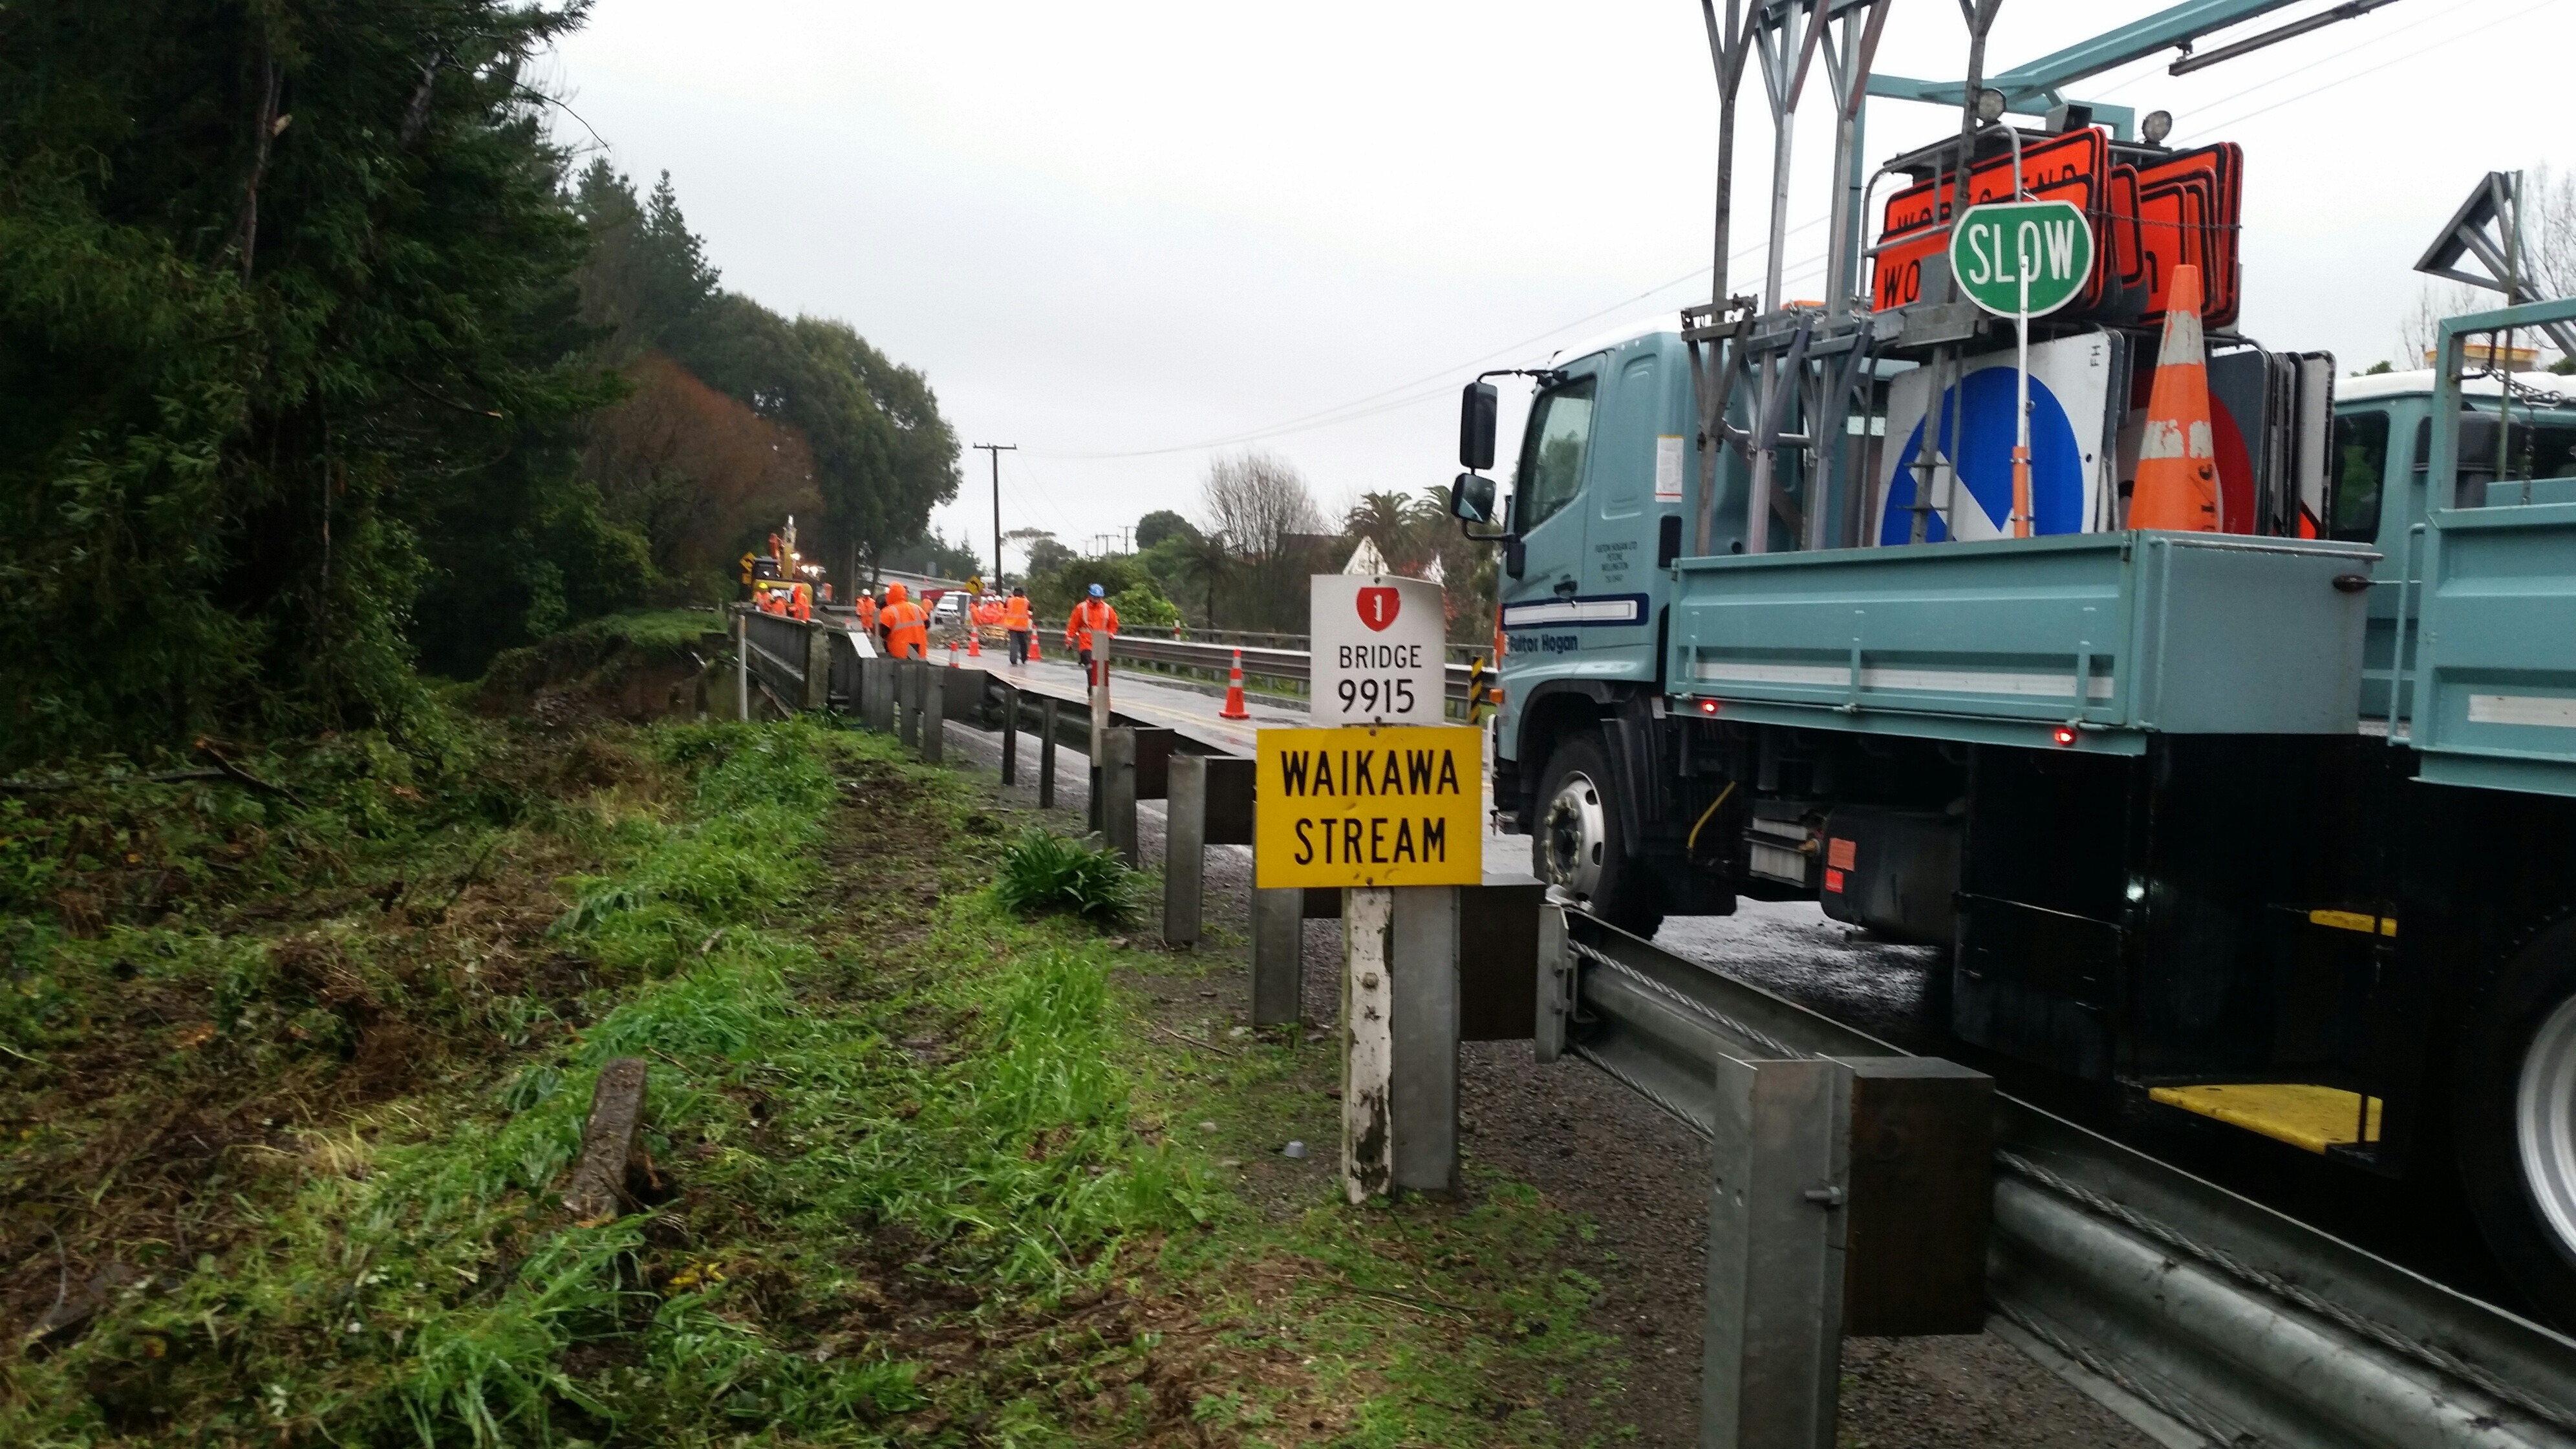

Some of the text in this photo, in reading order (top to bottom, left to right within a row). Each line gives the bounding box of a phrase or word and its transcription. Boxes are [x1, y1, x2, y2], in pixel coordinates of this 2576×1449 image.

[1968, 219, 2075, 285] SLOW
[1884, 259, 1921, 309] WO
[1374, 594, 1382, 622] 1
[1340, 645, 1422, 669] BRIDGE
[1541, 634, 1578, 654] Hogan
[1338, 679, 1415, 713] 9915
[1280, 749, 1460, 797] WAIKAWA
[1294, 817, 1445, 864] STREAM
